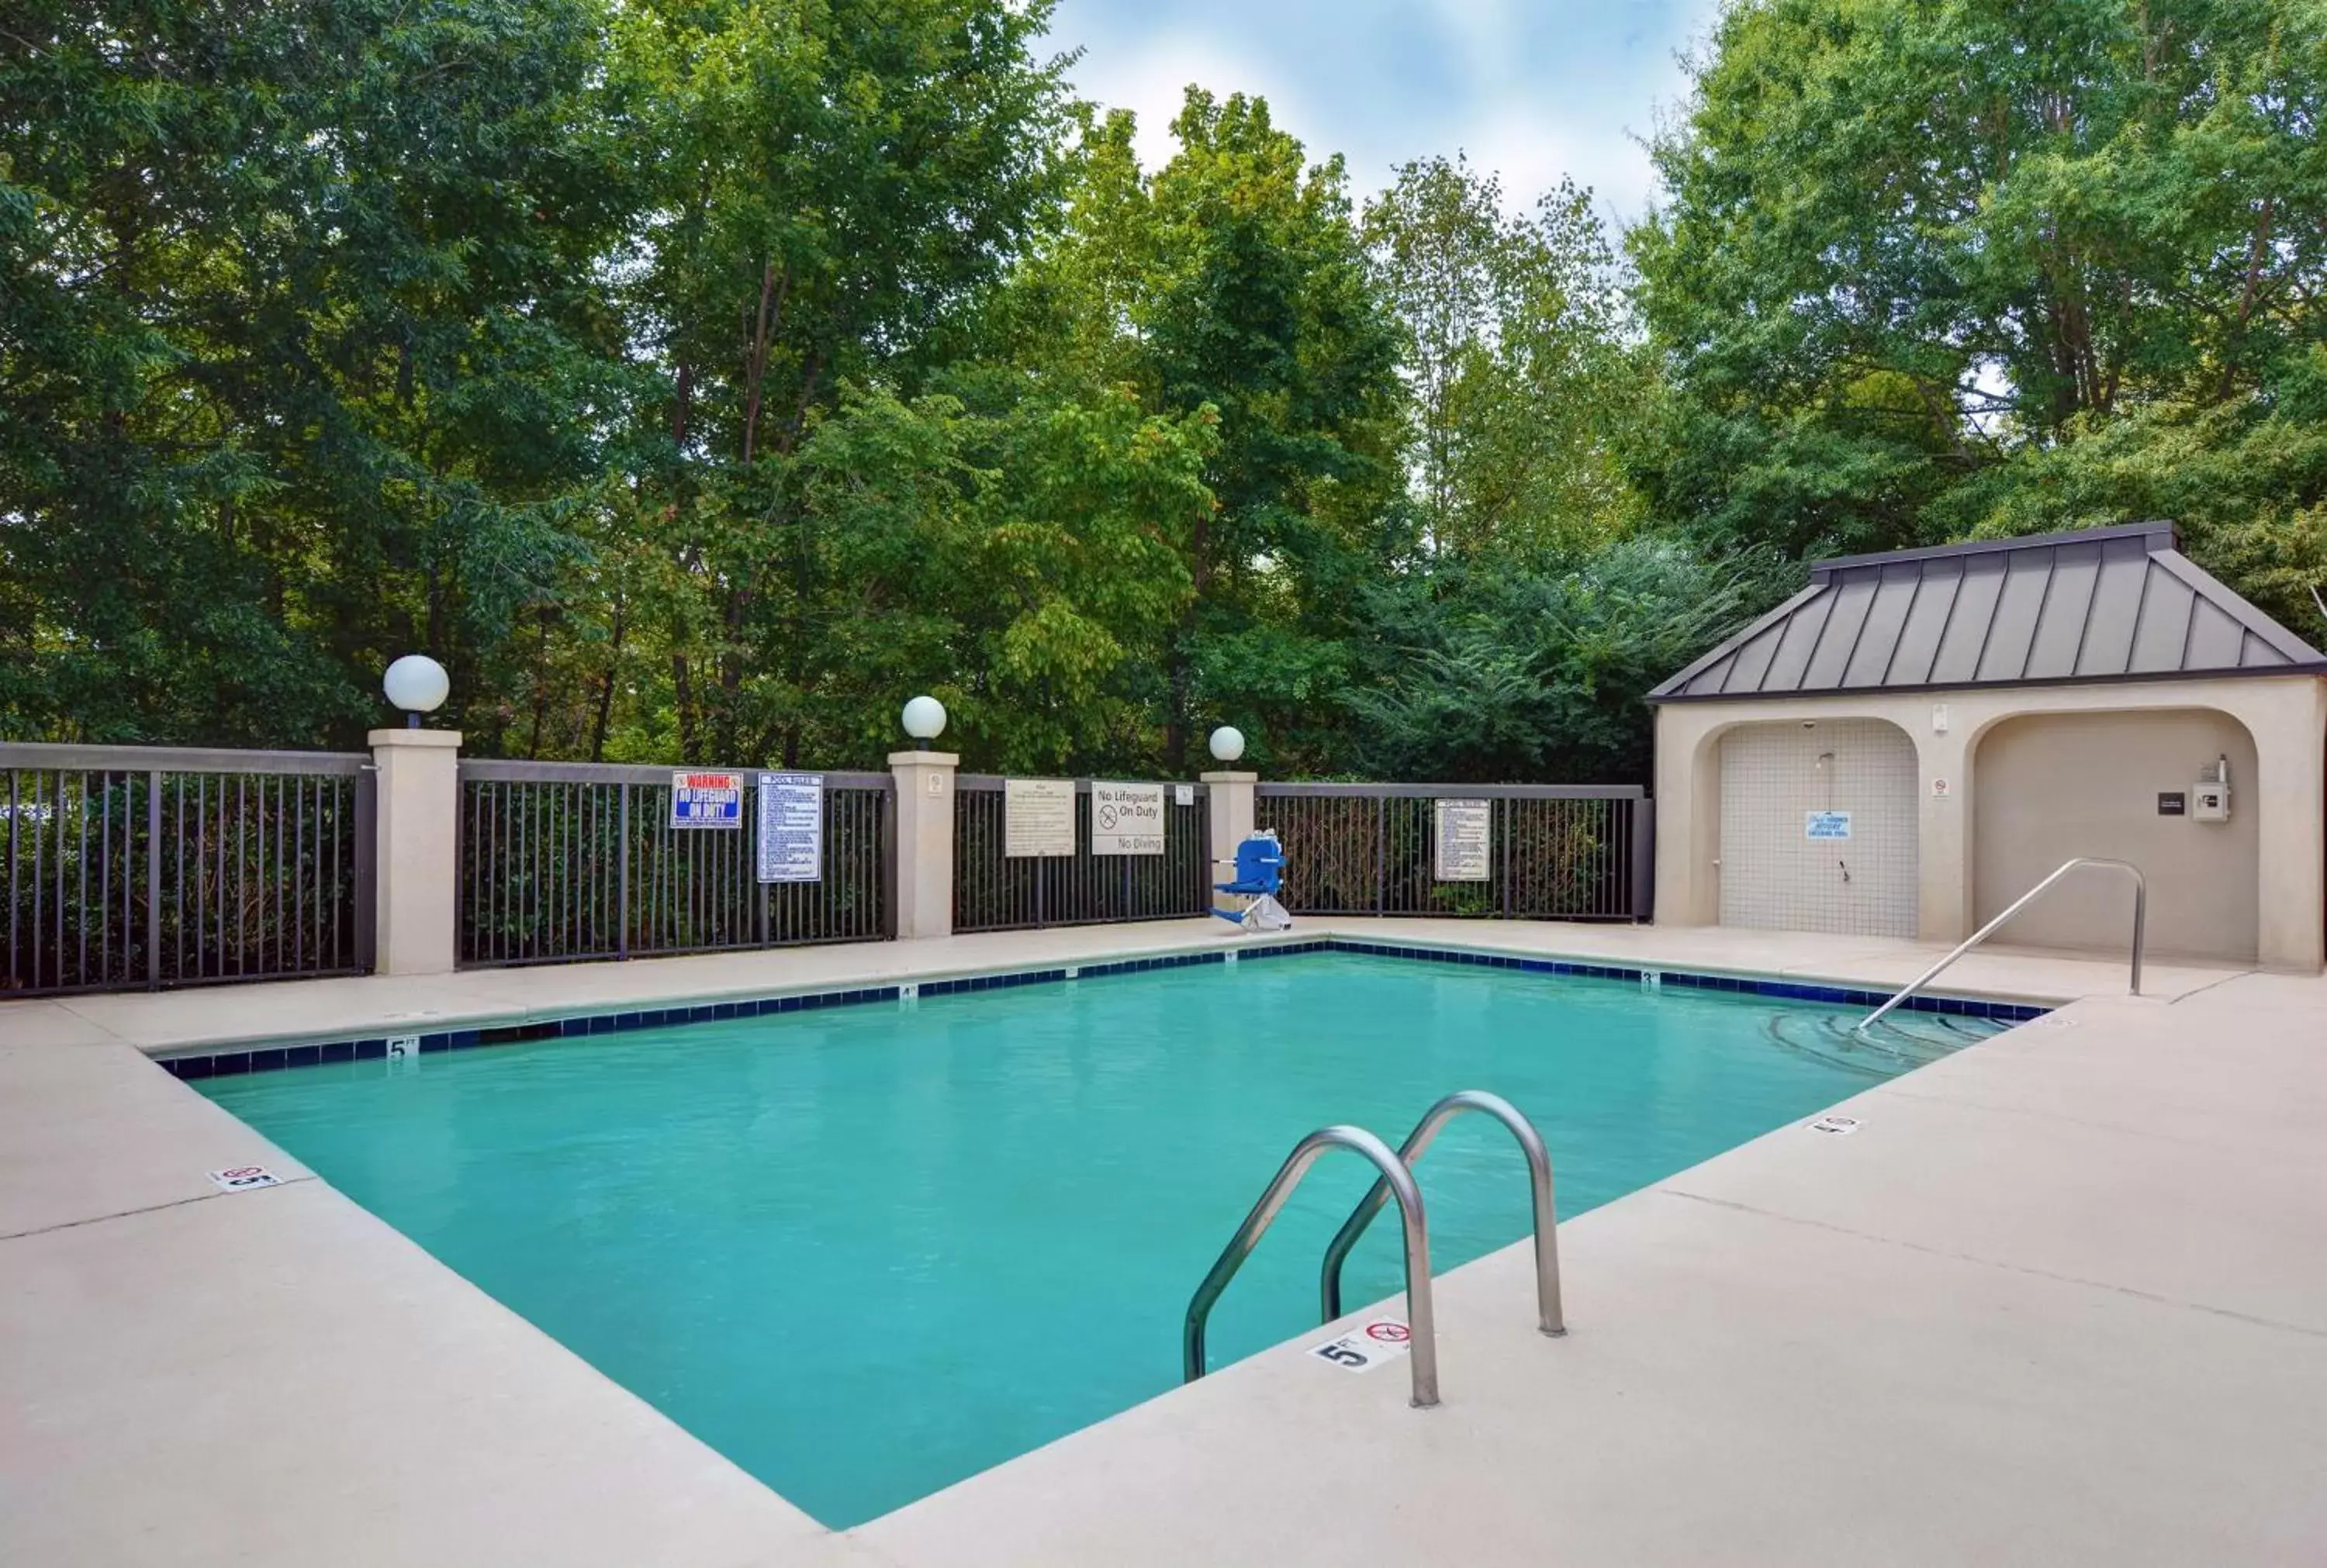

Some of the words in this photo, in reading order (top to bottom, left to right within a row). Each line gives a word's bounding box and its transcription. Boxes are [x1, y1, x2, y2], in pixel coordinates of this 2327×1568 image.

[687, 775, 730, 789] WARNING
[678, 789, 691, 803] NO
[693, 789, 737, 803] LIFEGUARD
[1098, 790, 1112, 801] No
[1115, 790, 1158, 804] Lifeguard
[689, 802, 702, 817] ON
[703, 802, 726, 817] DUTY
[1119, 806, 1133, 817] On
[1136, 806, 1158, 820] Duty
[1119, 838, 1132, 849] No
[1133, 838, 1161, 851] Diving
[391, 1041, 405, 1058] 5
[1318, 1345, 1368, 1366] 5
